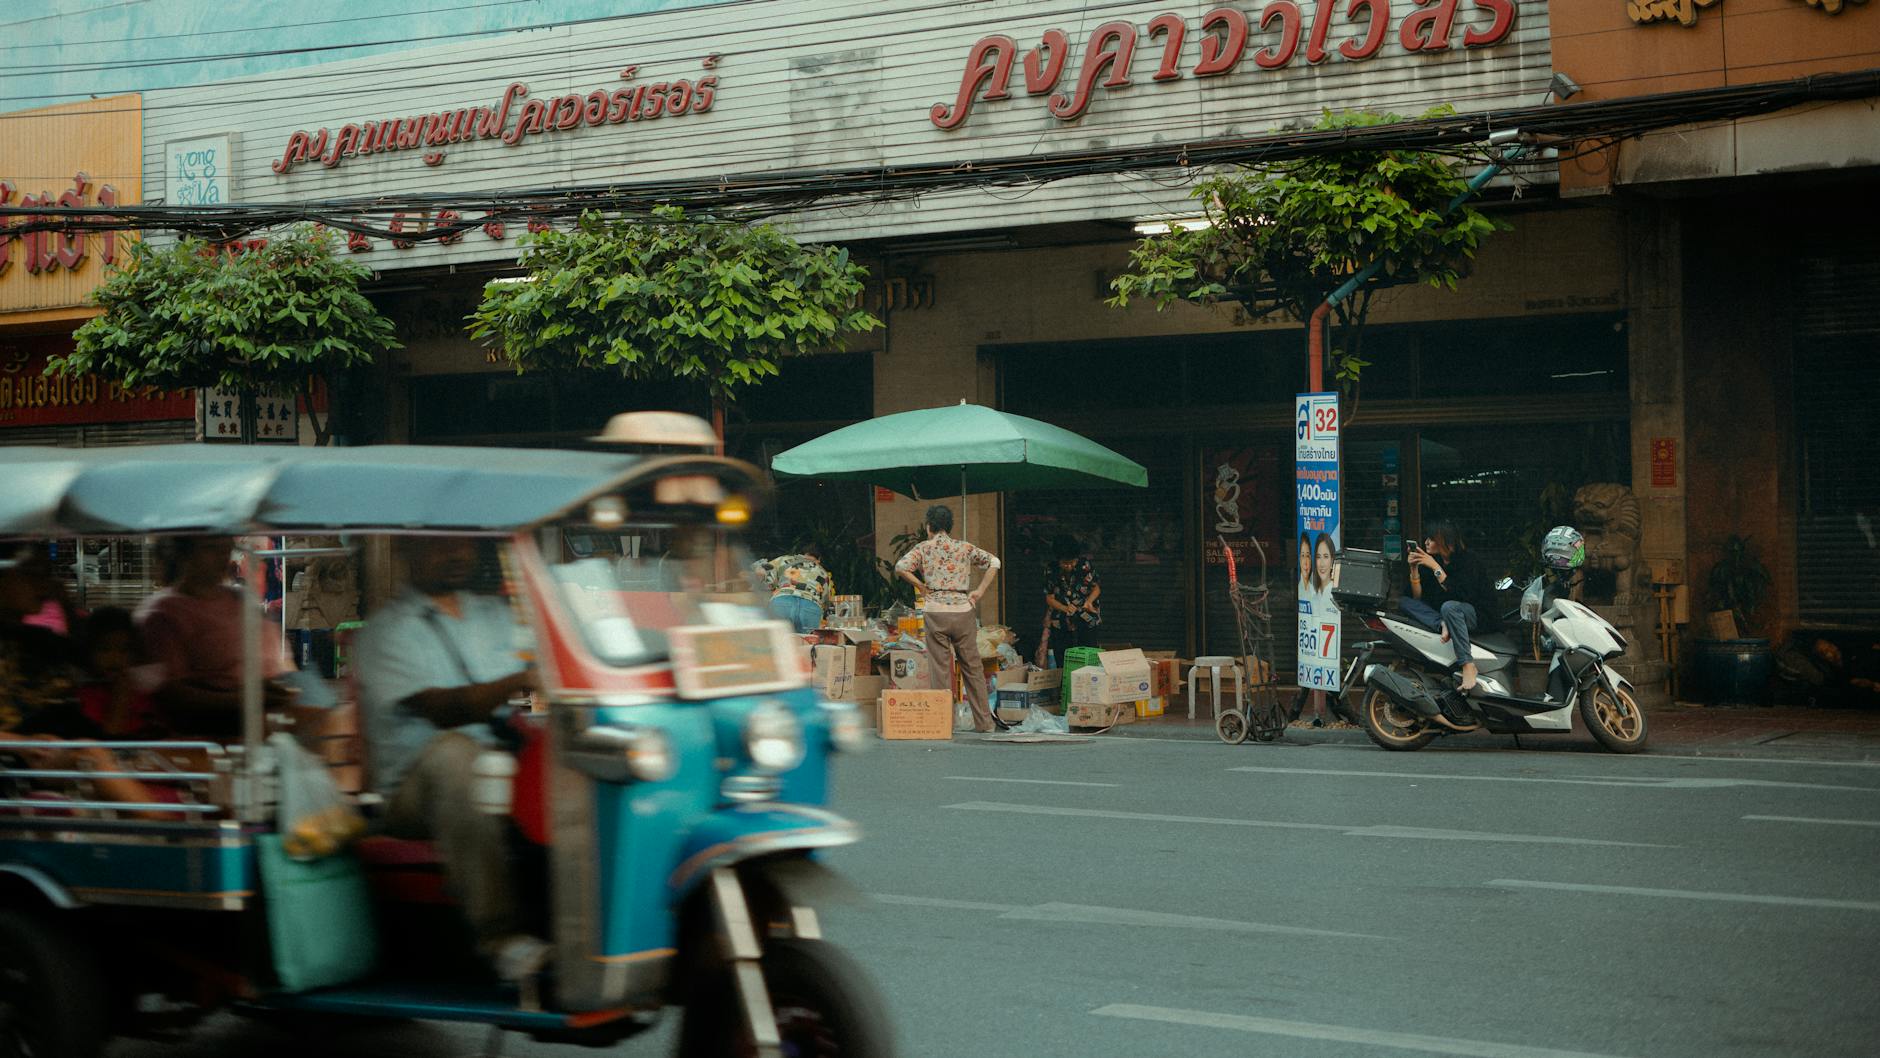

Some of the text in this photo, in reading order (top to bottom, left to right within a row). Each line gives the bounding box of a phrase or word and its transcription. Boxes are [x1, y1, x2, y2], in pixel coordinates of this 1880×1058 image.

[175, 148, 216, 182] Kong
[1315, 408, 1337, 432] 32
[1321, 624, 1335, 657] 7
